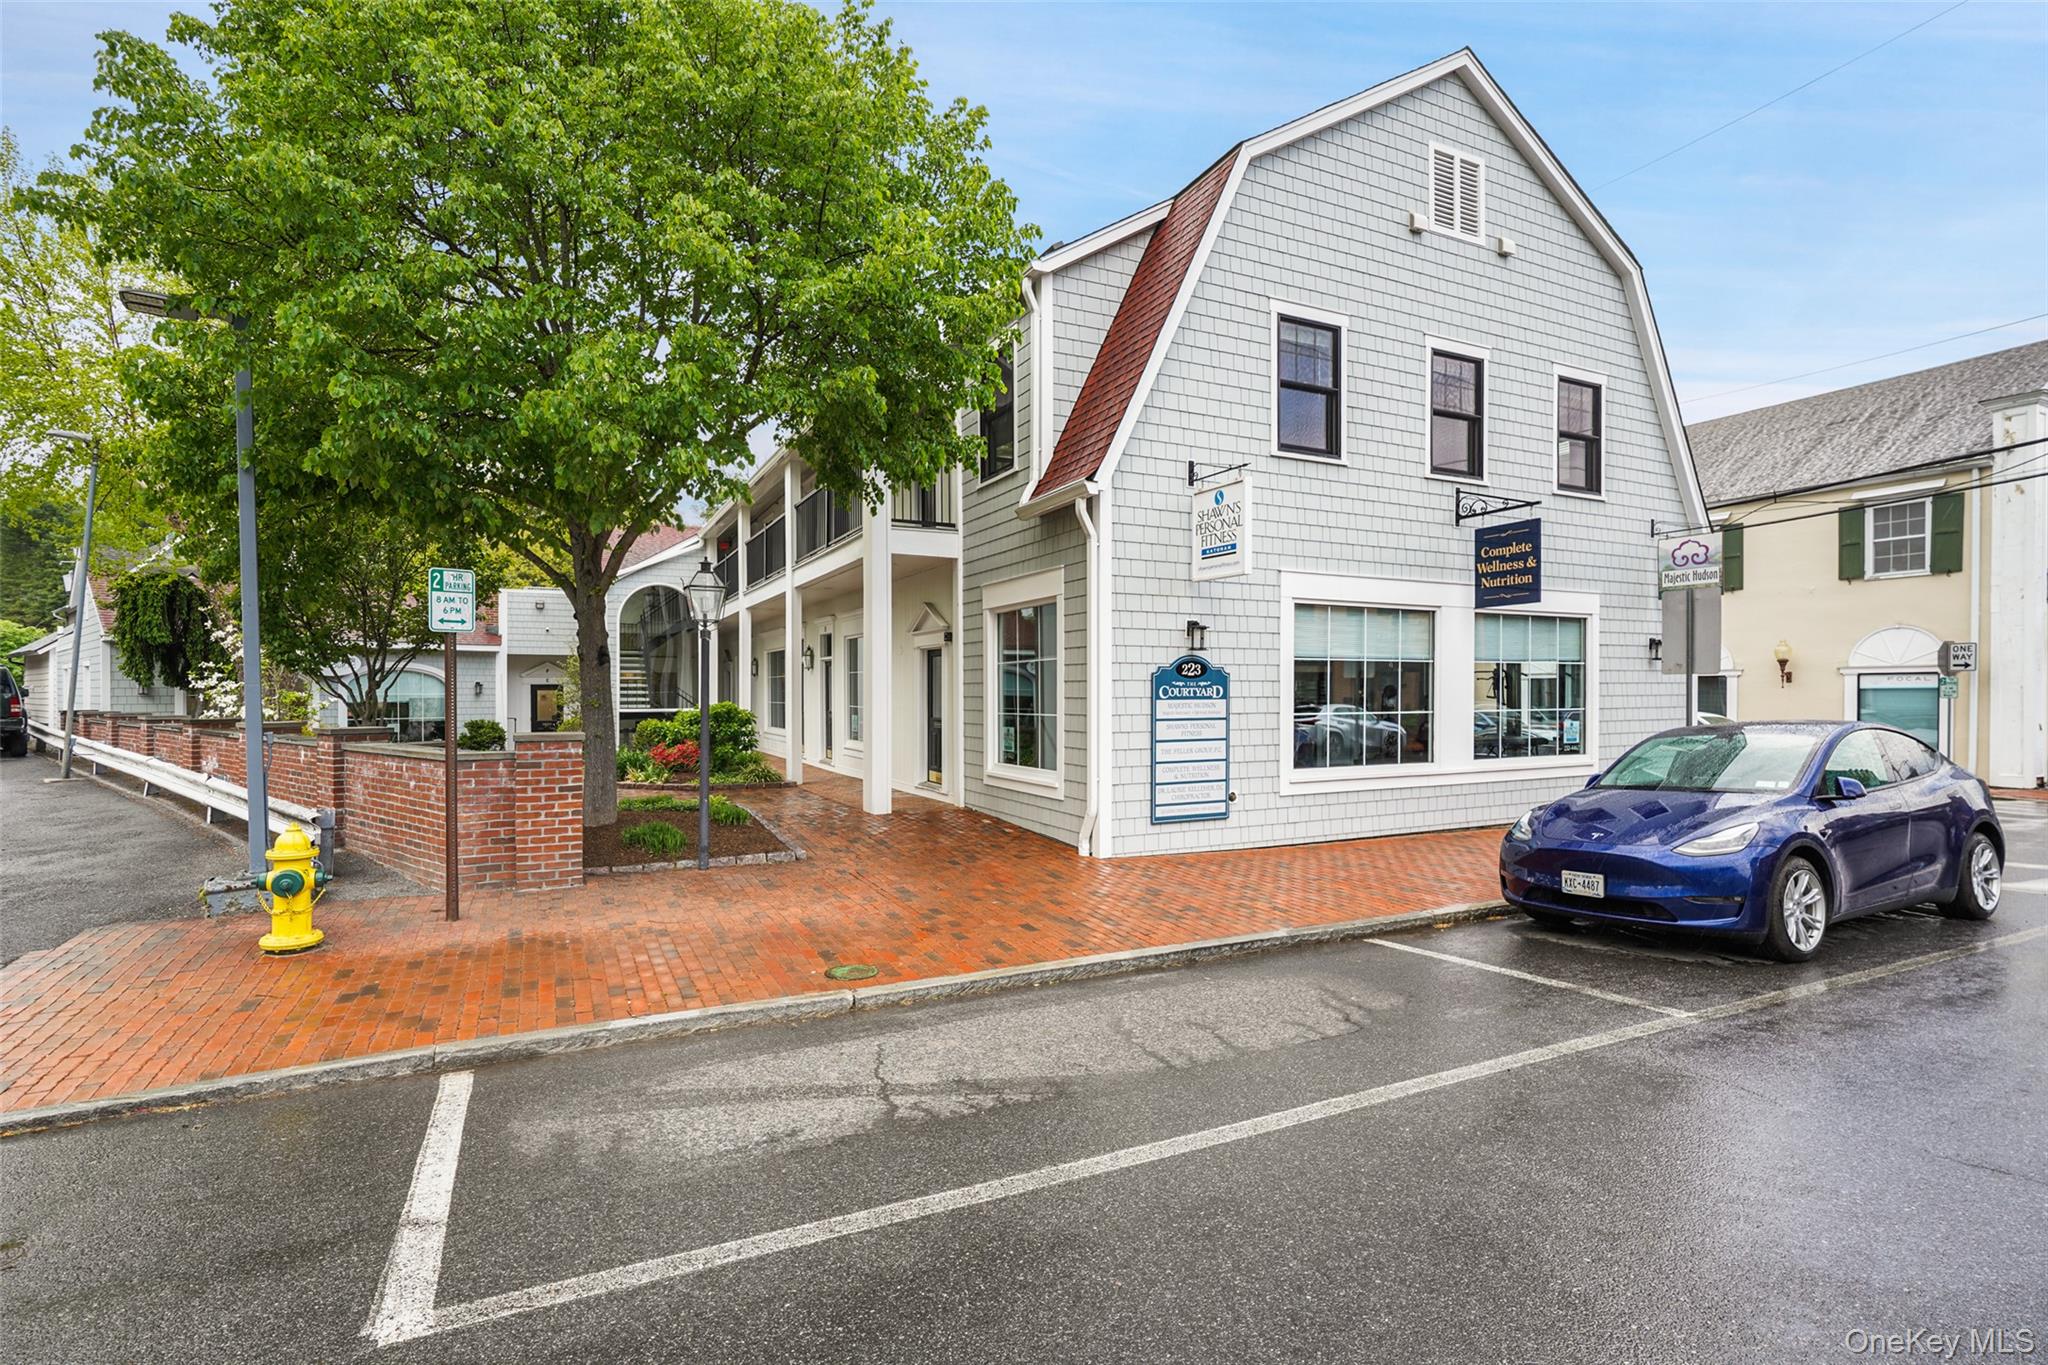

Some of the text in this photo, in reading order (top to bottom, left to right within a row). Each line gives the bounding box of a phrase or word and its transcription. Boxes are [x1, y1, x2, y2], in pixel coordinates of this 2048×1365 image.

[1195, 514, 1243, 536] PERSONAL
[1201, 529, 1237, 548] FITNESS
[1480, 542, 1533, 558] Complete
[1477, 556, 1537, 574] Wellness &
[433, 572, 464, 588] 2 HR
[1481, 573, 1533, 588] Nutrition
[1663, 569, 1718, 585] Majestic Hudson
[445, 582, 471, 590] PARKING
[436, 595, 469, 605] 8 AM TO
[1952, 644, 1973, 653] ONE
[1952, 653, 1973, 661] WAY
[1181, 662, 1202, 676] 223
[1158, 685, 1224, 699] COURTYARD
[1563, 877, 1600, 892] KXC-4487
